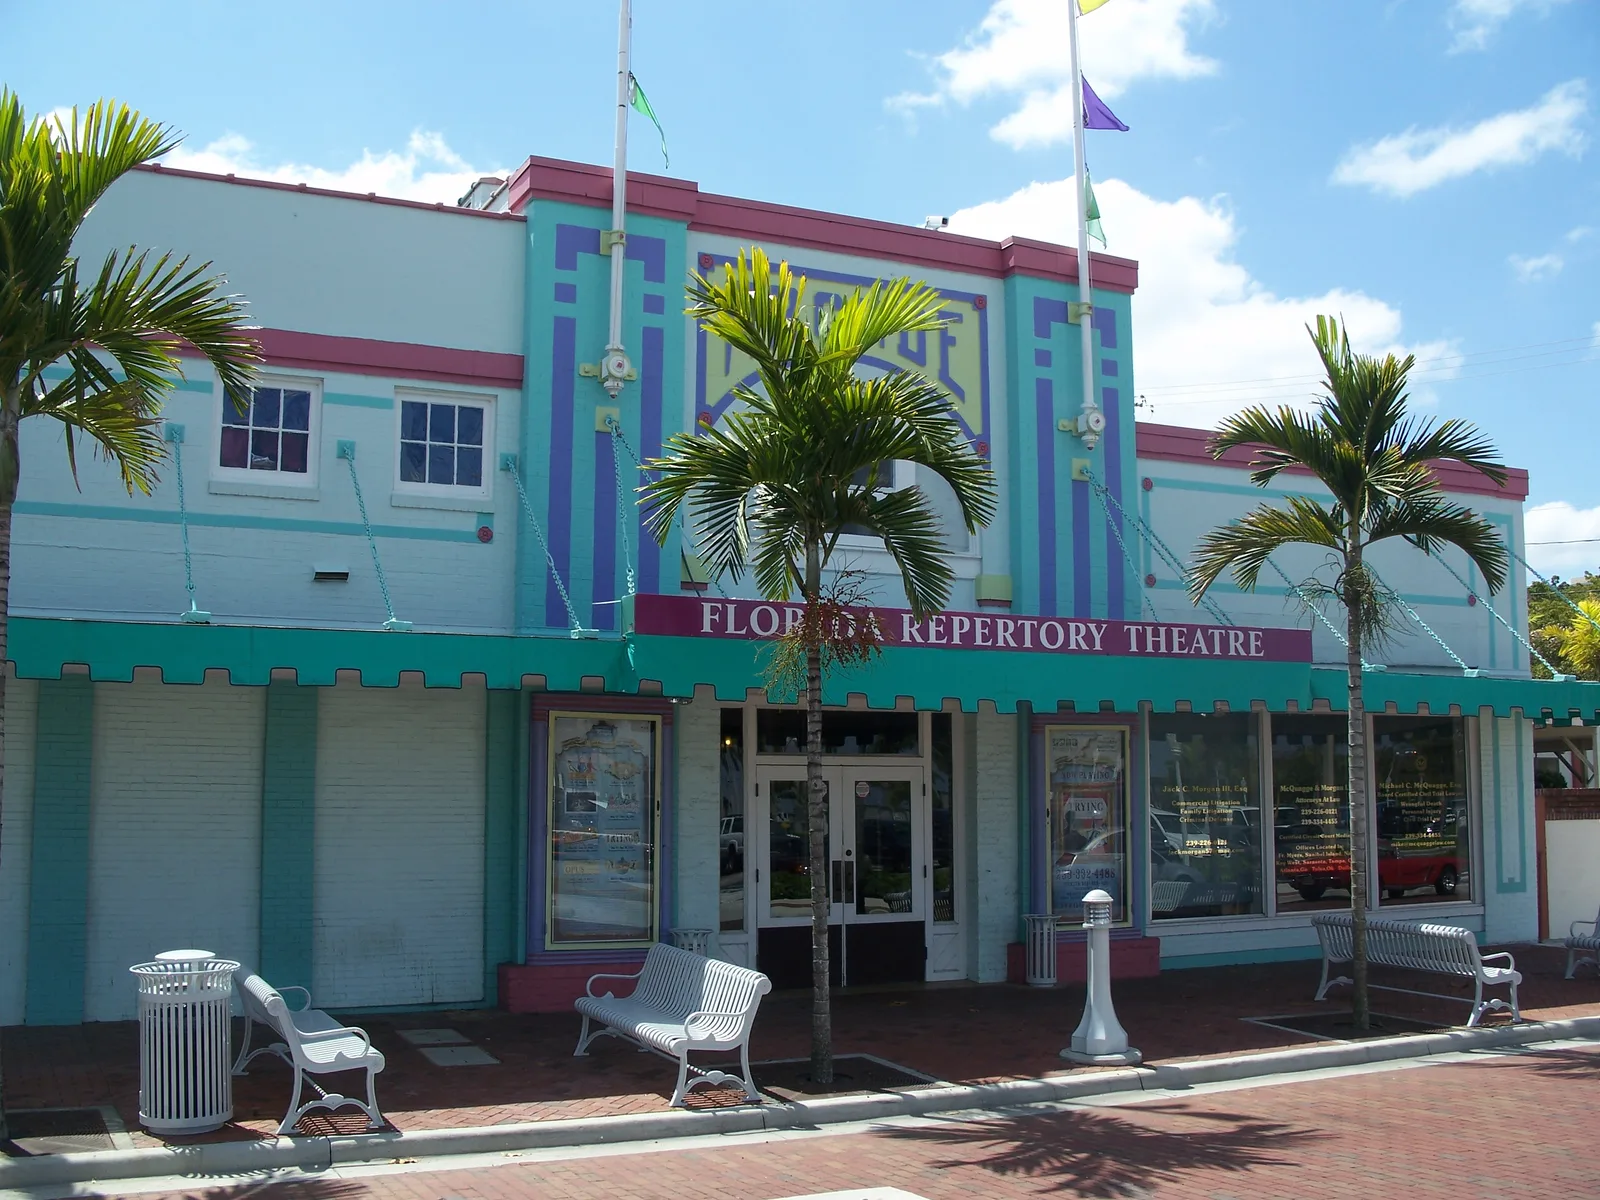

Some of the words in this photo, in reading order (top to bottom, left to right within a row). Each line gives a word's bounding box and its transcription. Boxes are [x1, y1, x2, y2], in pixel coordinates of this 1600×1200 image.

[900, 613, 1108, 651] REPERTORY
[1124, 625, 1265, 657] THEATRE
[1321, 785, 1344, 793] Morgan
